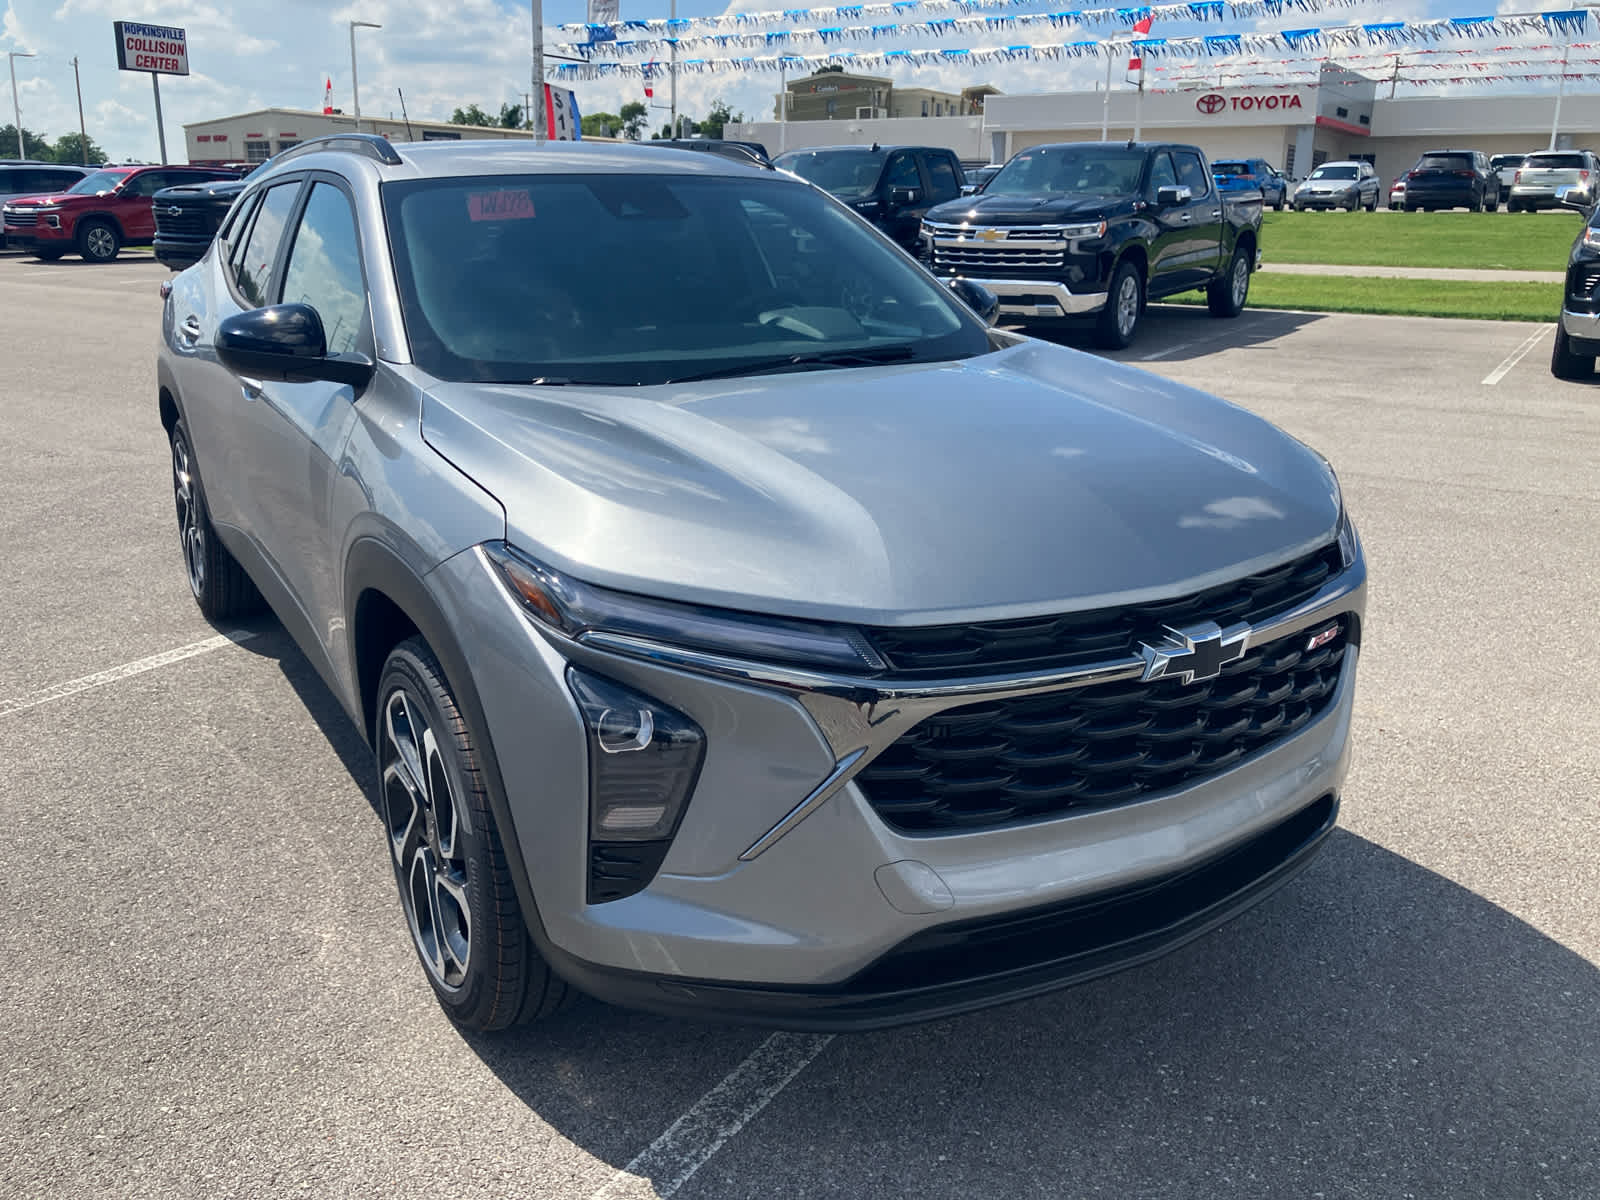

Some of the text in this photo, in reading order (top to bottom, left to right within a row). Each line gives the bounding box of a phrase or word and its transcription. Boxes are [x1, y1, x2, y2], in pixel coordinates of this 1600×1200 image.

[124, 23, 184, 40] HOPKINSVILLE
[126, 37, 185, 56] COLLISION
[135, 54, 179, 71] CENTER
[1230, 94, 1302, 111] TOYOTA
